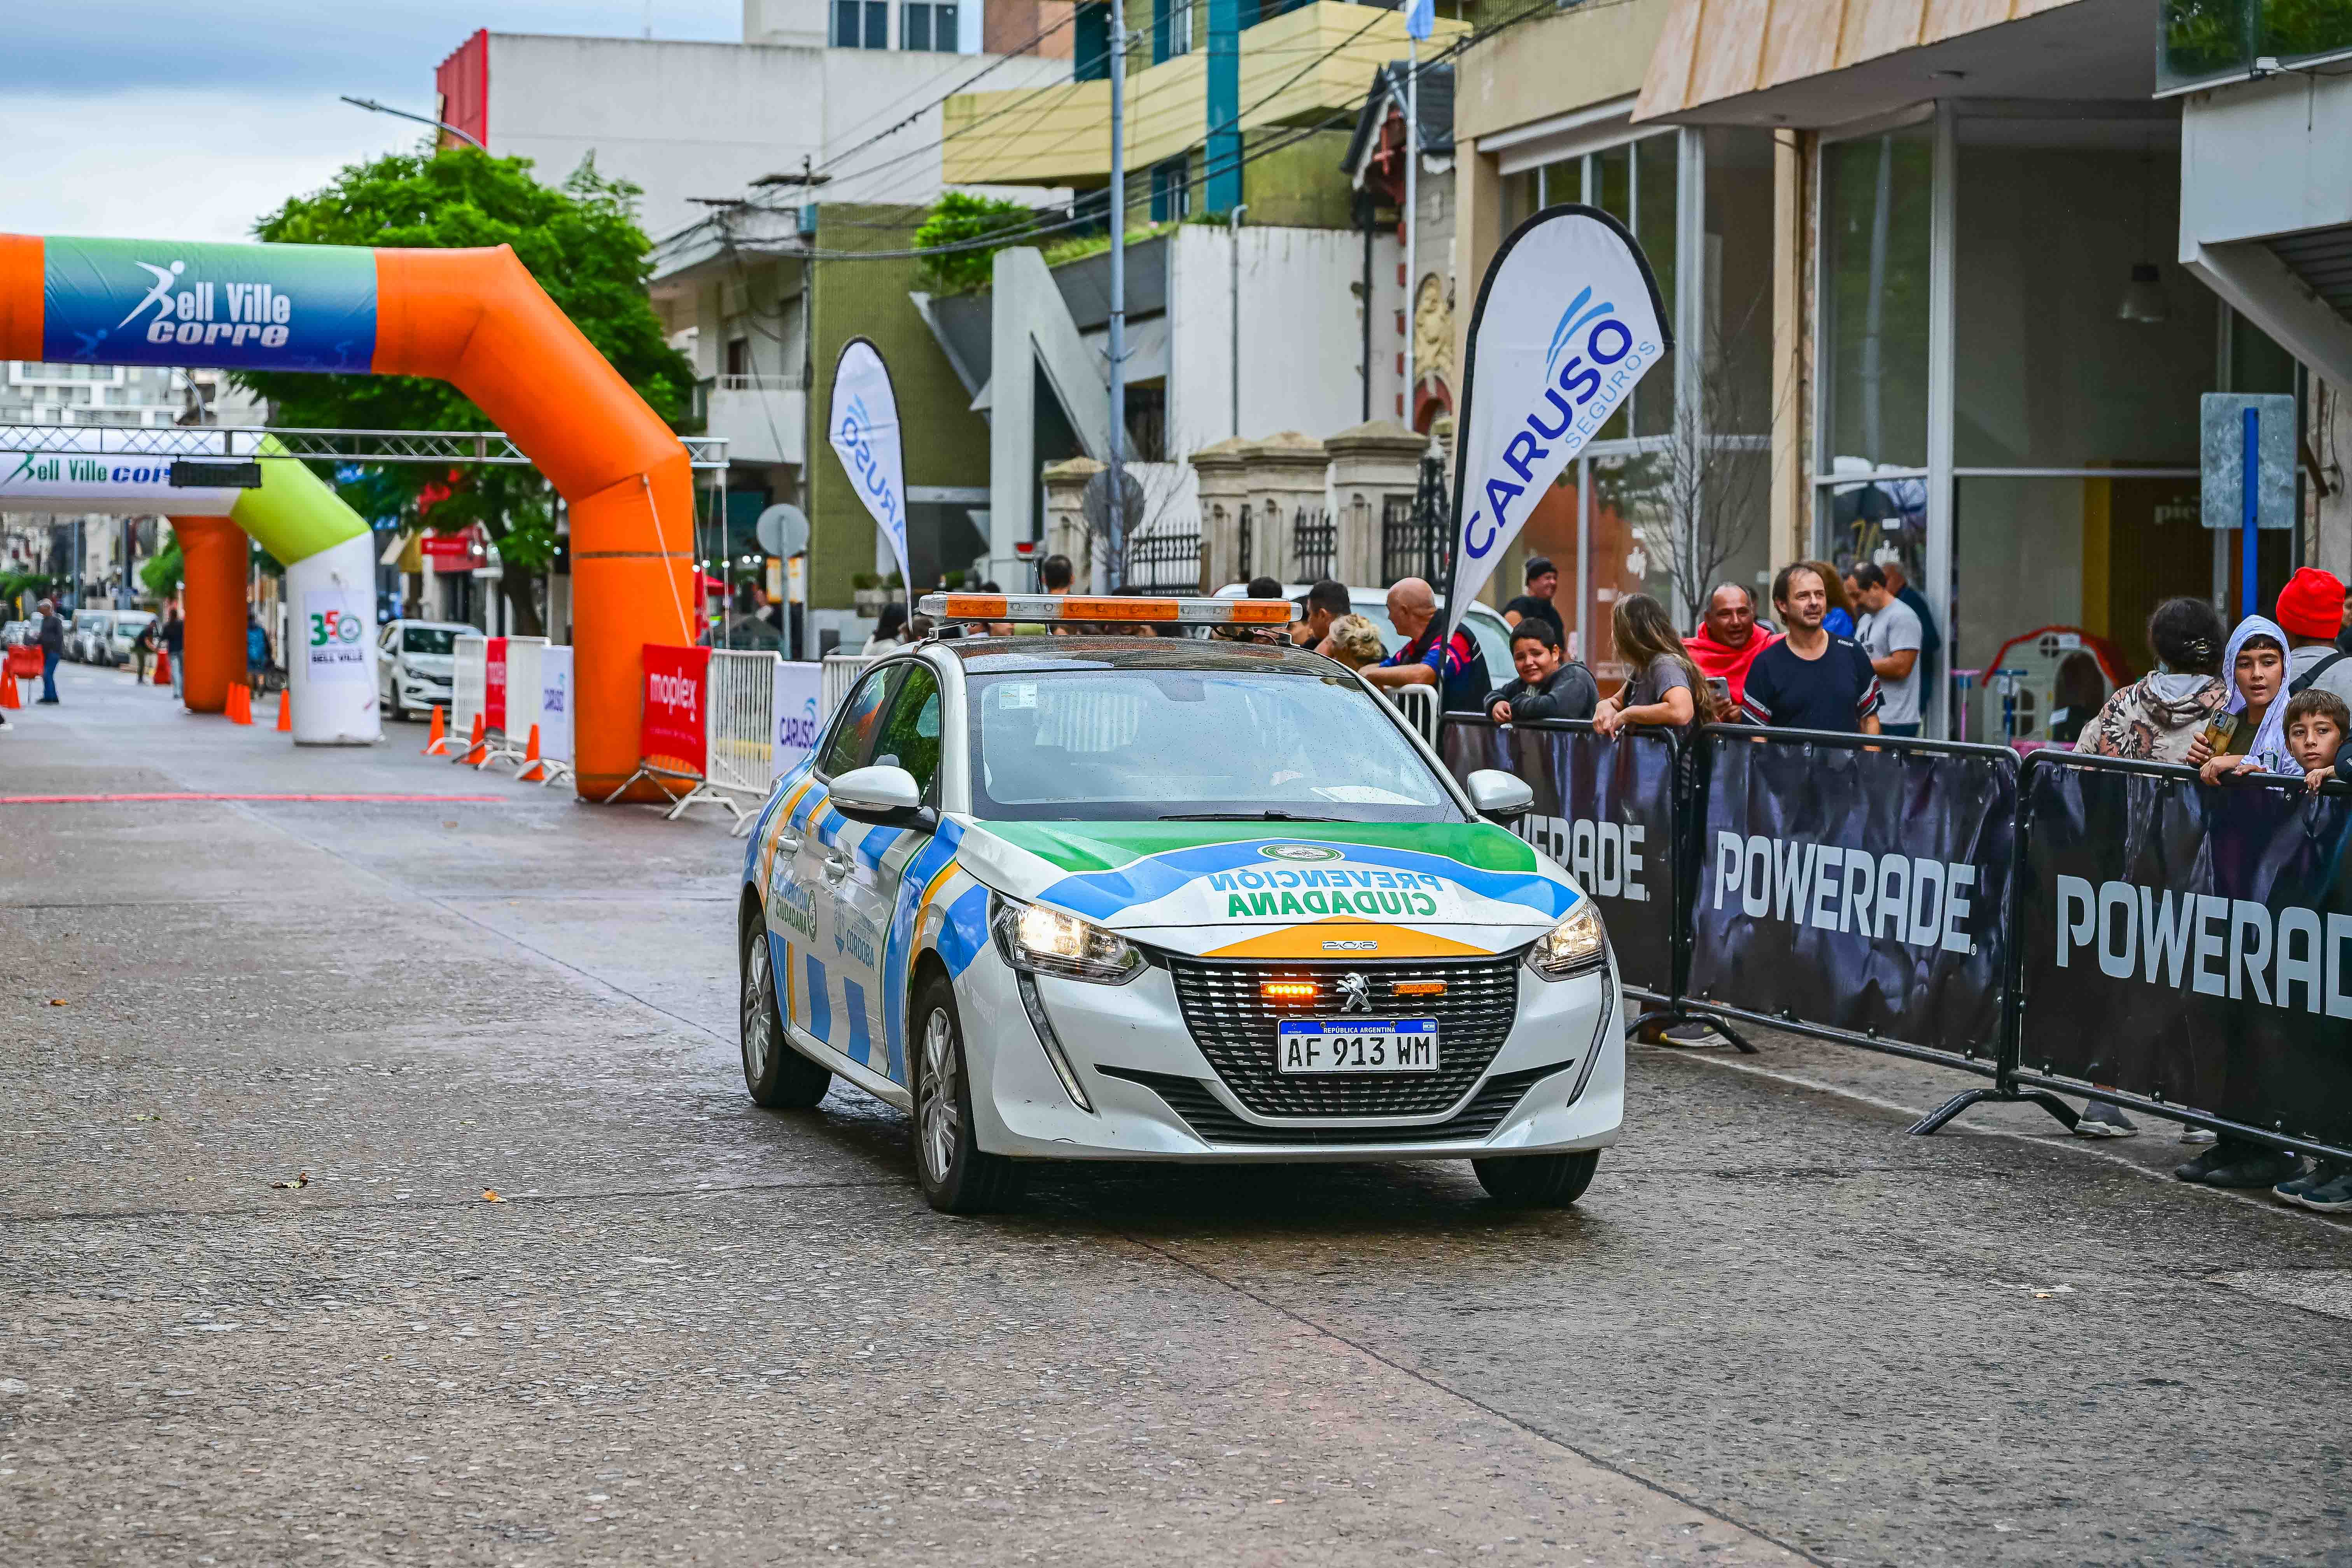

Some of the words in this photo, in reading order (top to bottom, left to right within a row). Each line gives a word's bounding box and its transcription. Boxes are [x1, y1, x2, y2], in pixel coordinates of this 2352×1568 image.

[226, 282, 291, 324] Ville
[147, 321, 290, 348] corre
[1565, 341, 1656, 449] SEGUROS
[1465, 319, 1633, 560] CARUSO
[69, 459, 107, 481] Ville
[310, 611, 362, 646] 350
[1713, 830, 1975, 954] POWERADE
[776, 897, 807, 936] CIUDADANA
[1322, 941, 1378, 950] 208
[1287, 1037, 1322, 1066] AF
[1333, 1036, 1385, 1066] 913
[1396, 1036, 1432, 1066] WM
